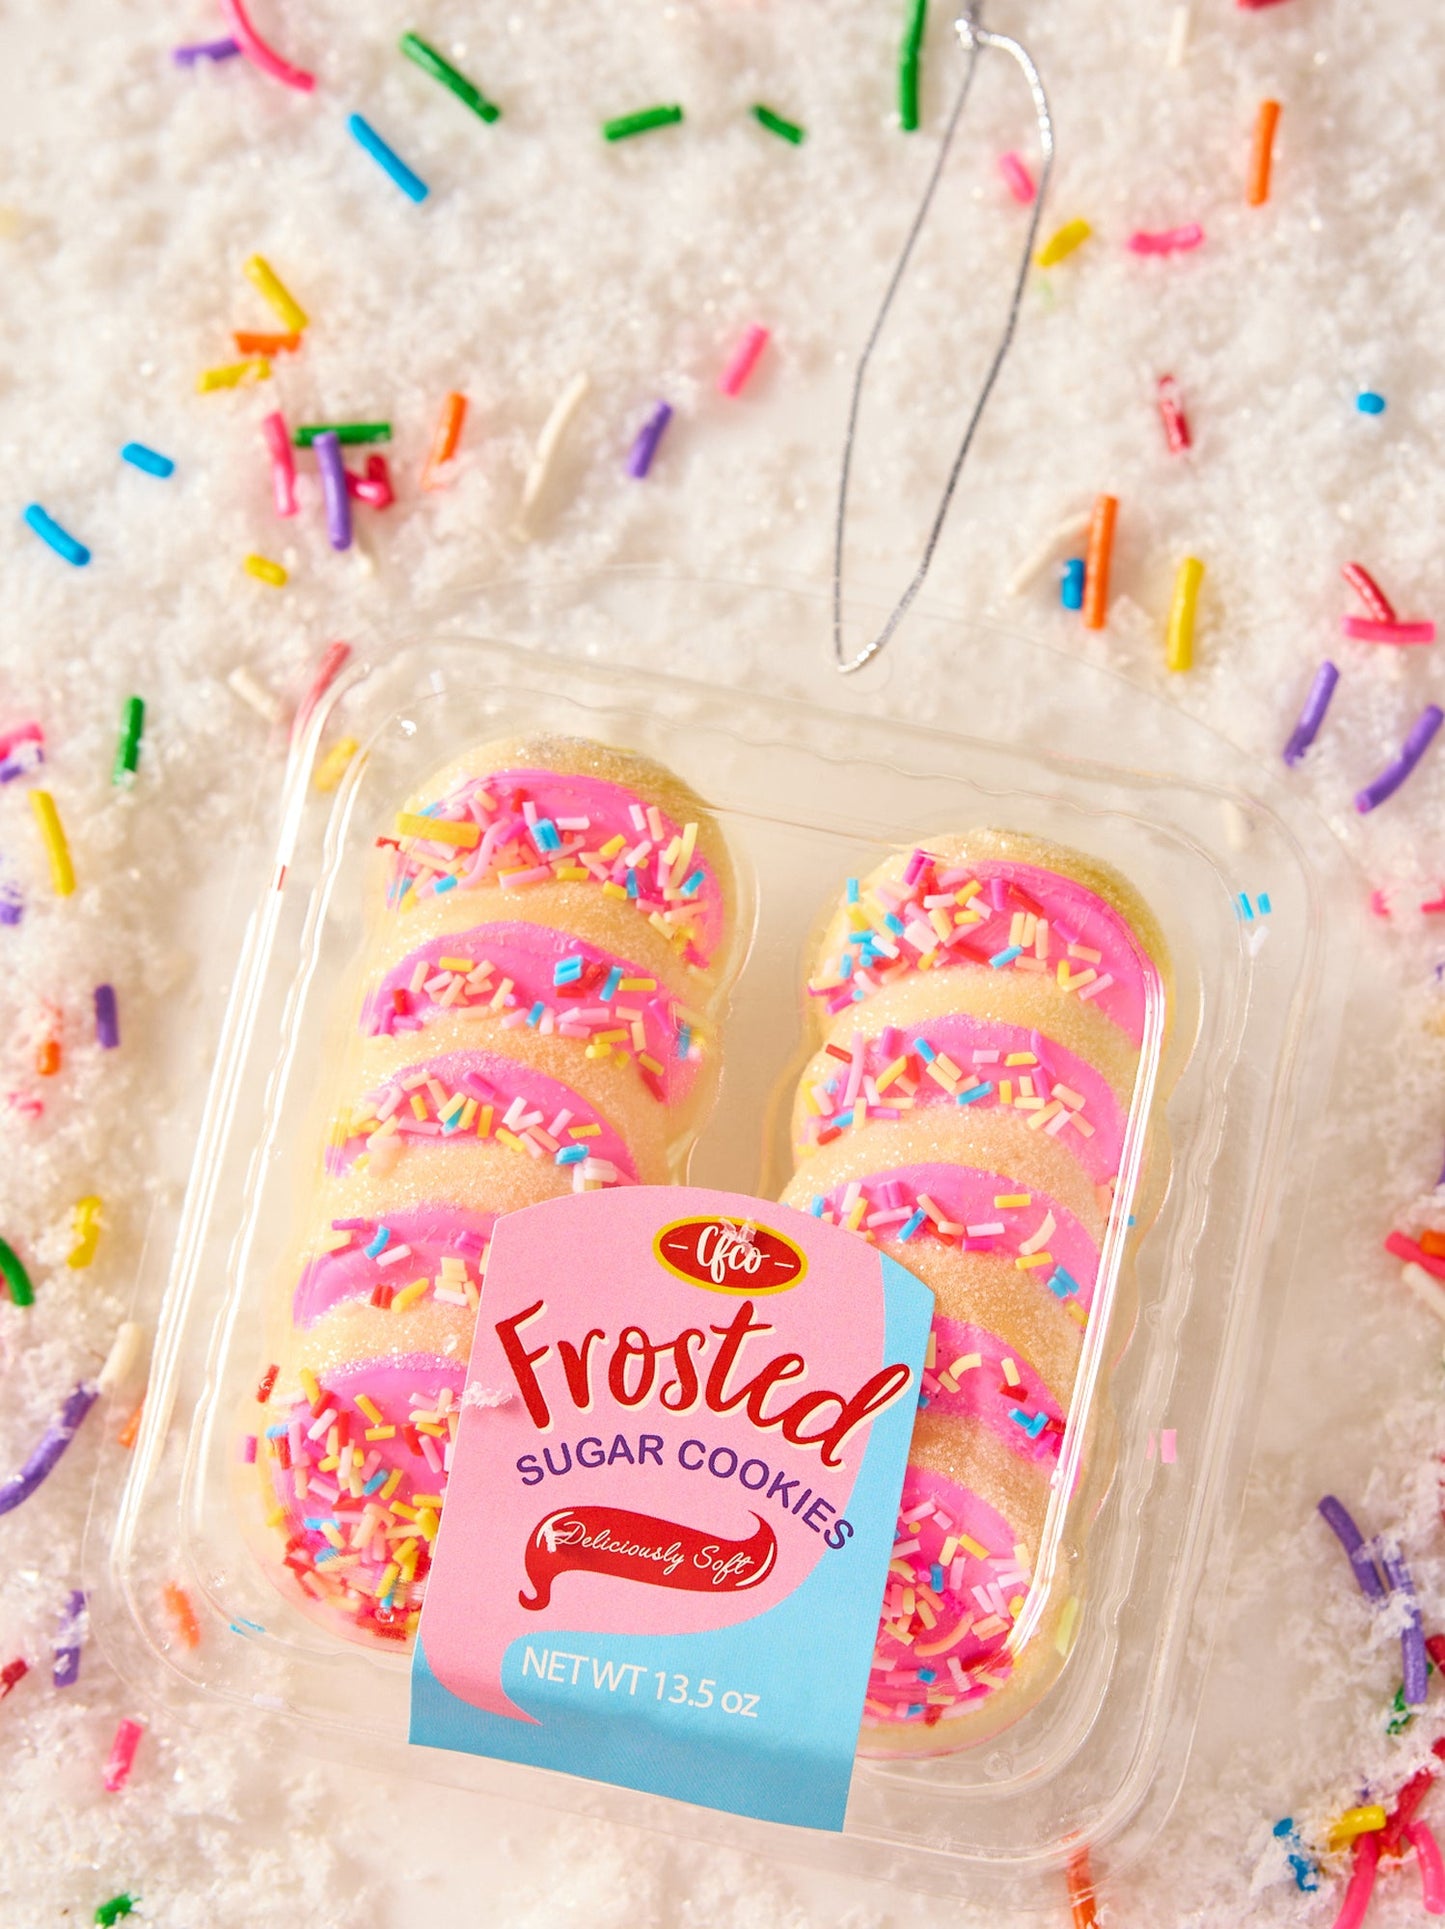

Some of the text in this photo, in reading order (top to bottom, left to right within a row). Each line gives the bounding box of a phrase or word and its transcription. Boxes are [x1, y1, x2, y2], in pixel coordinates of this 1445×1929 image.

[495, 1300, 913, 1472] Frosted
[516, 1434, 854, 1550] SUGAR COOKIES
[555, 1521, 754, 1585] Deliciously Soft
[522, 1645, 761, 1719] NET WT 13.5 oz
